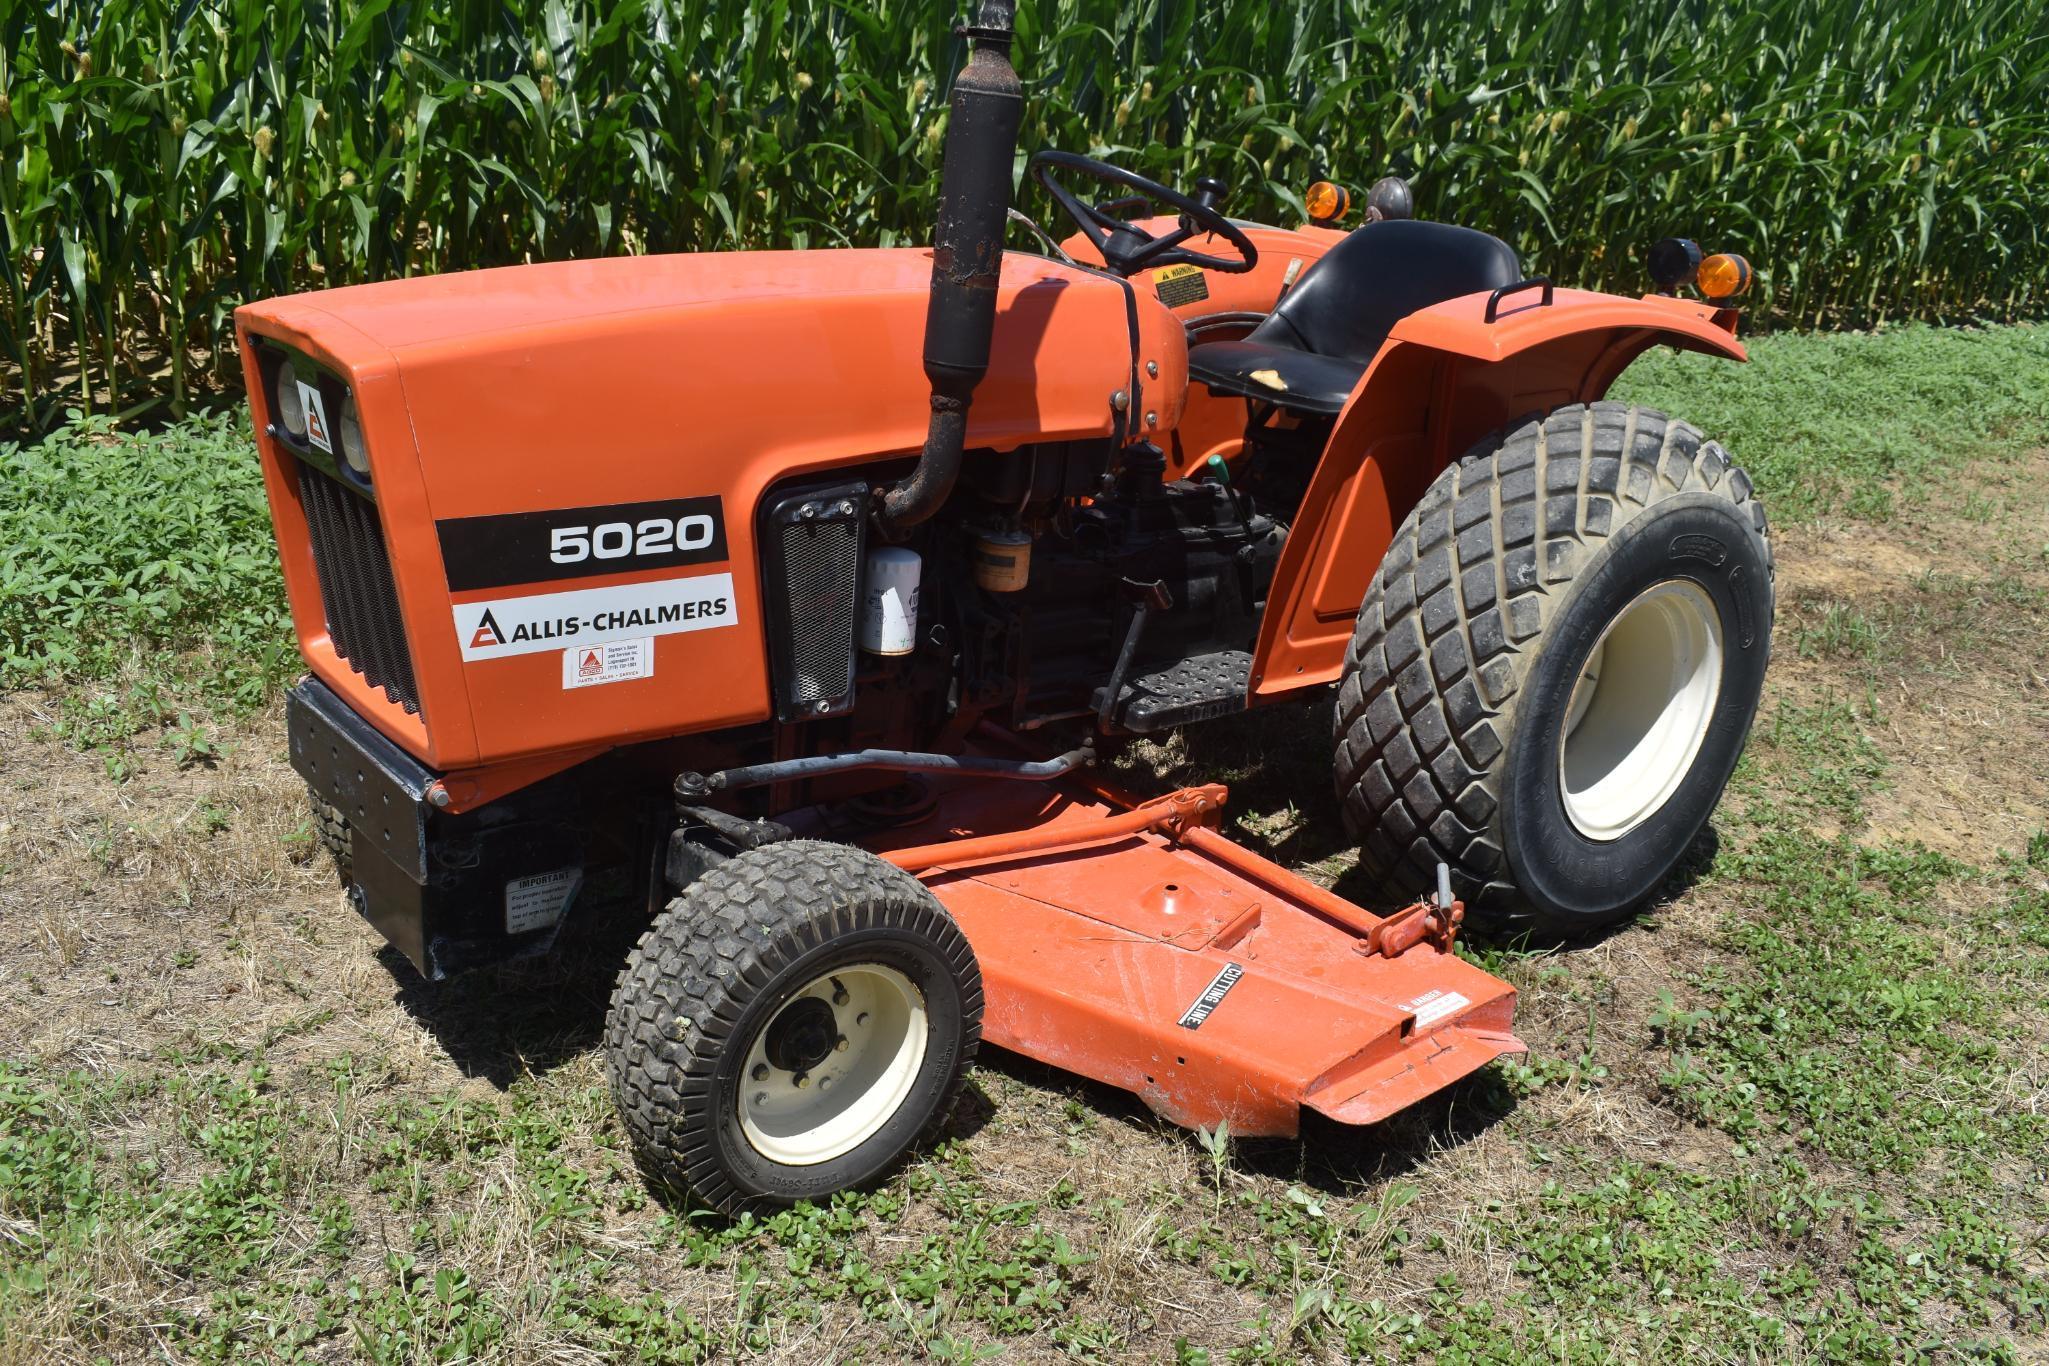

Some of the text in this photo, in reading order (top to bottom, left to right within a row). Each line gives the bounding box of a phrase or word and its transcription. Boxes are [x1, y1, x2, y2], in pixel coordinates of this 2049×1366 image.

[550, 514, 714, 564] 5020
[511, 598, 727, 643] ALLIS-CHALMERS
[582, 668, 601, 676] AGCO
[519, 872, 569, 888] IMPORTANT
[523, 891, 542, 900] proper
[511, 902, 529, 911] adjust
[1187, 967, 1243, 1026] CUTTING LINE
